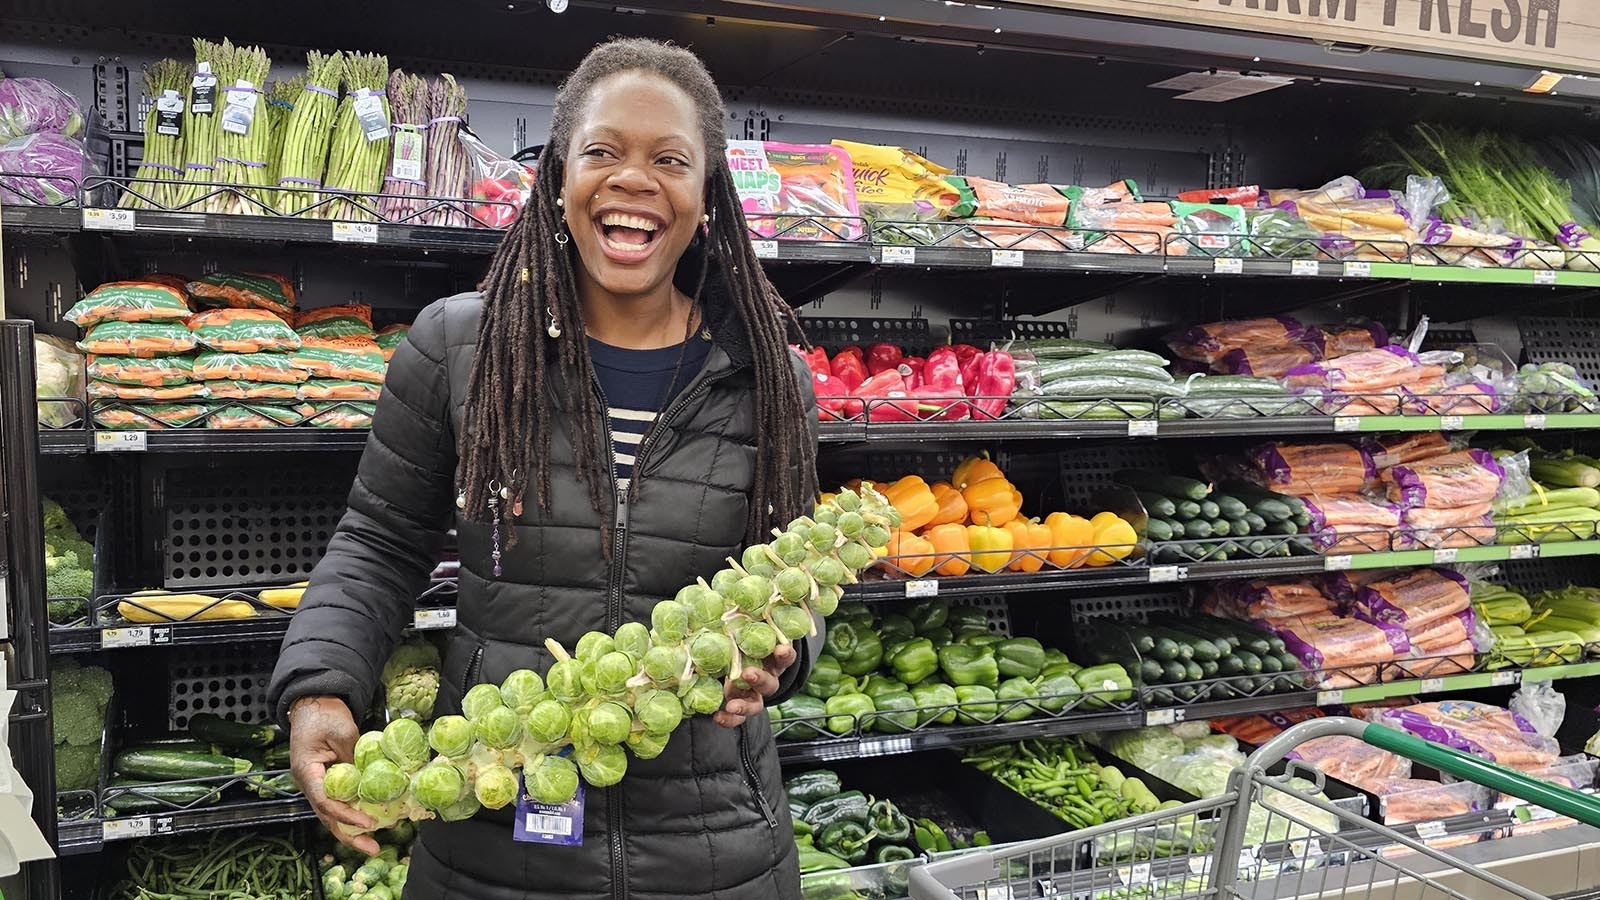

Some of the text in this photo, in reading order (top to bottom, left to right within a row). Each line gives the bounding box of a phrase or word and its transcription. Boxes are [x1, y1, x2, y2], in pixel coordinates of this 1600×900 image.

[730, 157, 763, 171] WEET
[732, 171, 779, 192] NAPS
[852, 167, 890, 185] uick
